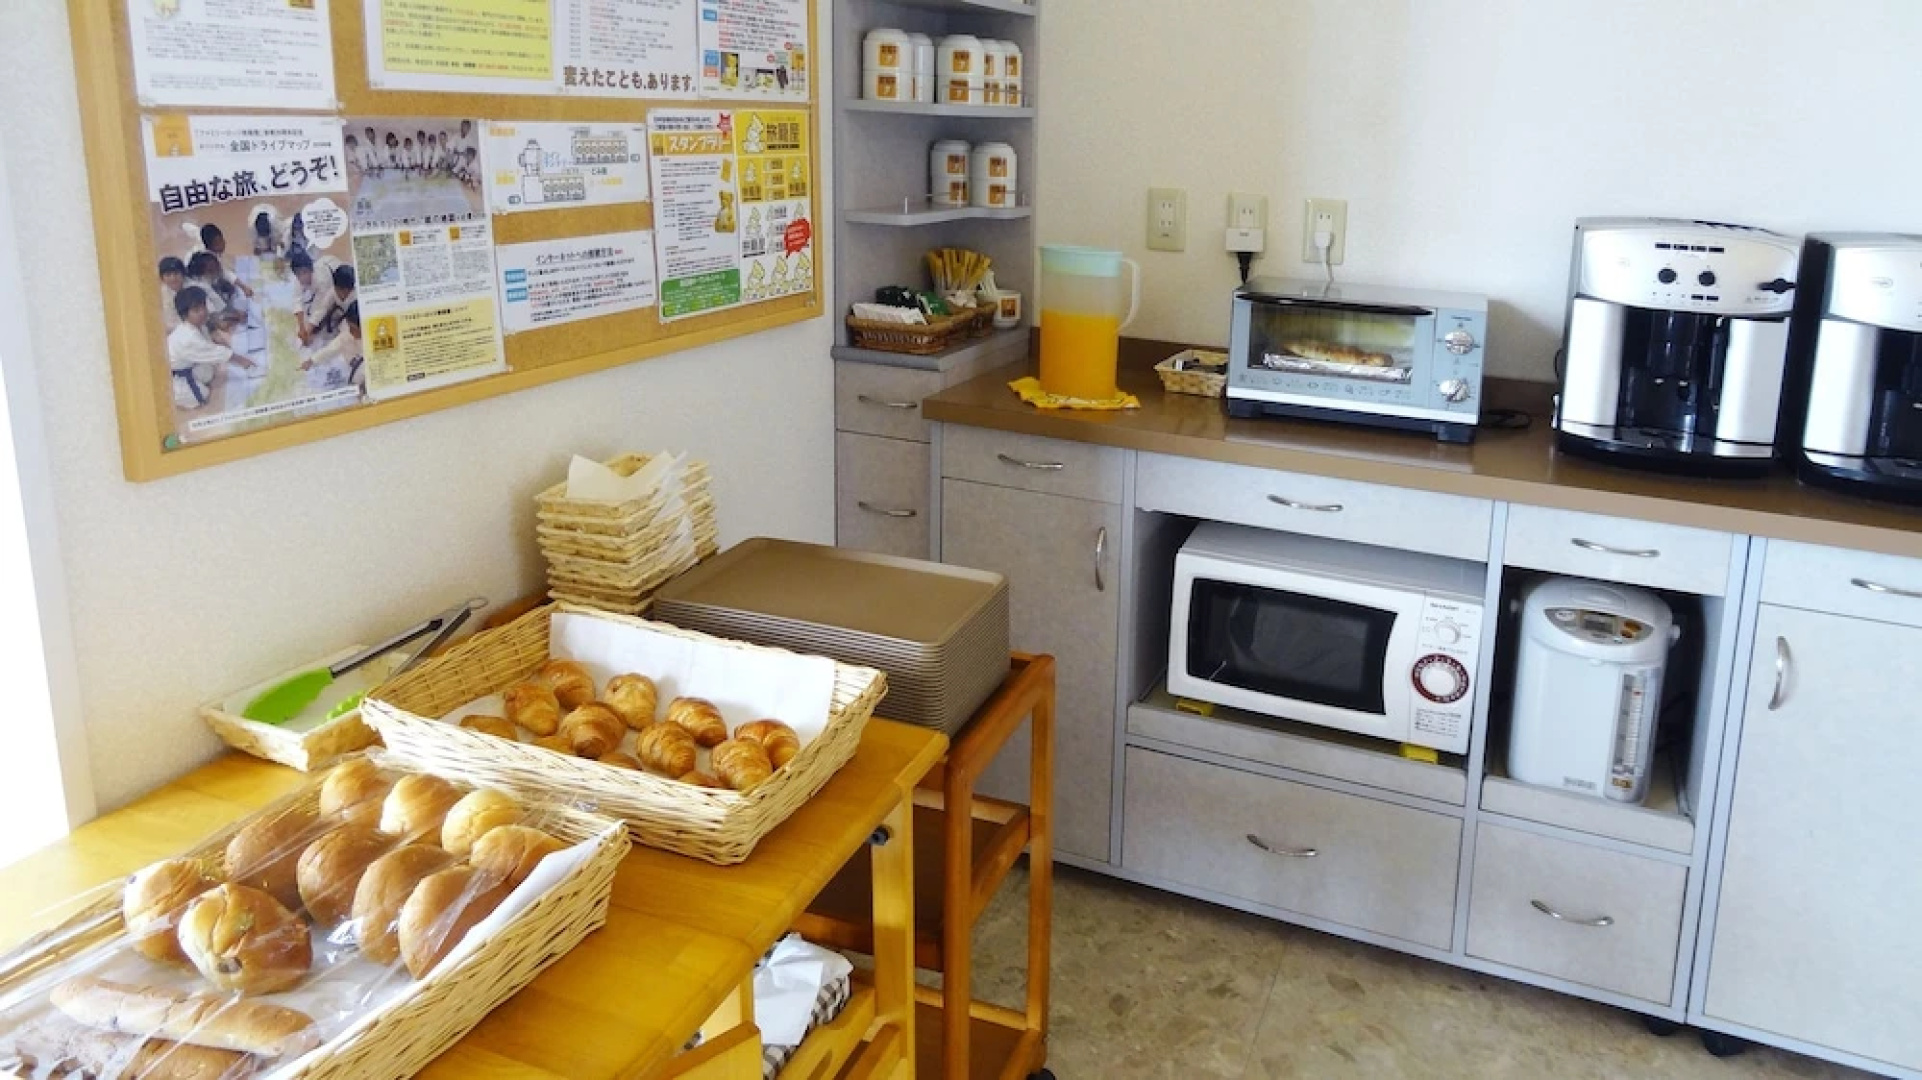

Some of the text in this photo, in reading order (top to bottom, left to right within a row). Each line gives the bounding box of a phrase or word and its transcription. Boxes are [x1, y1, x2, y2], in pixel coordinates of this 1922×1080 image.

[564, 65, 696, 92] 変えたことも、あります。
[230, 139, 310, 152] 全国ドライブマップ
[158, 155, 339, 213] 自由な旅、どうぞ!
